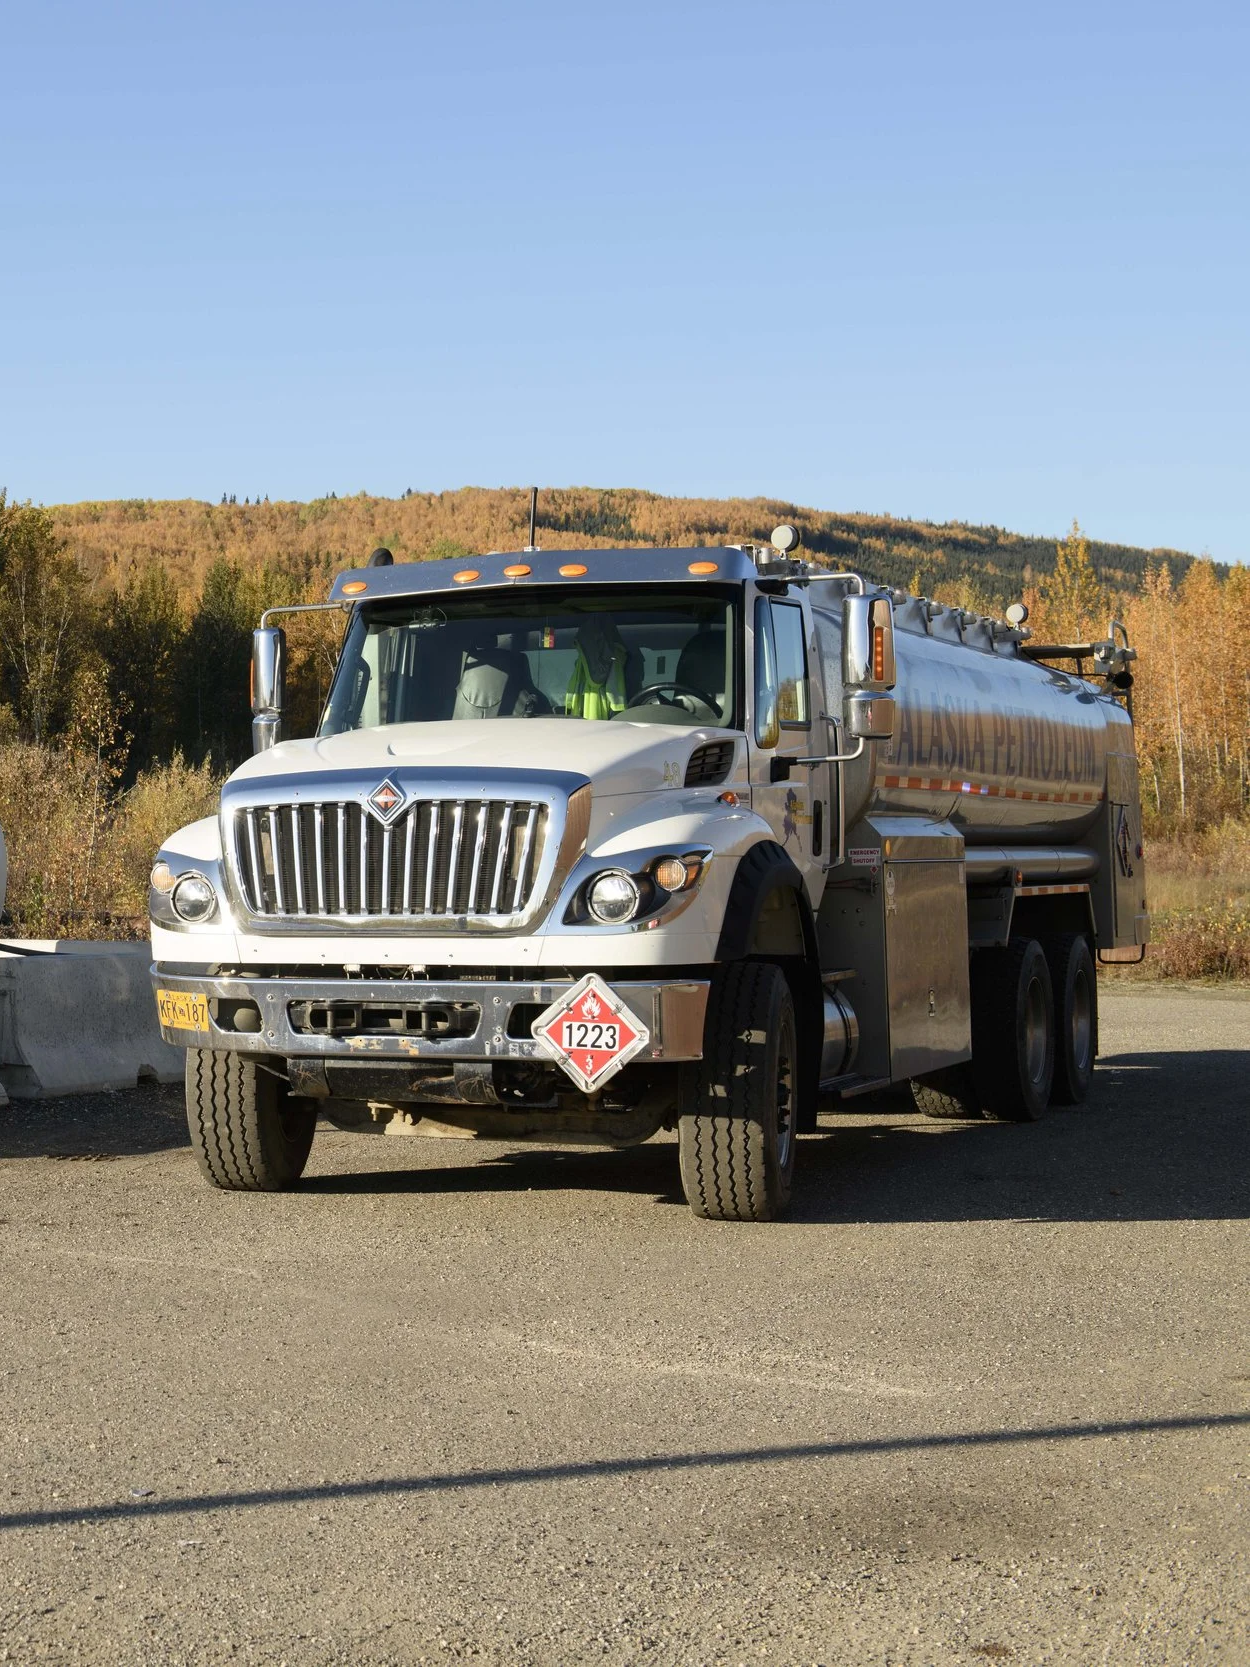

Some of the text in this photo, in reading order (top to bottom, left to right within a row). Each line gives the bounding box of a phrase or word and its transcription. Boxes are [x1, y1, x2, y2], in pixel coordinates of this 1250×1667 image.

[897, 687, 1096, 783] ALASKA PETROLEUM
[160, 1000, 205, 1023] KFK 187
[566, 1023, 617, 1049] 1223
[585, 1055, 593, 1071] 3
